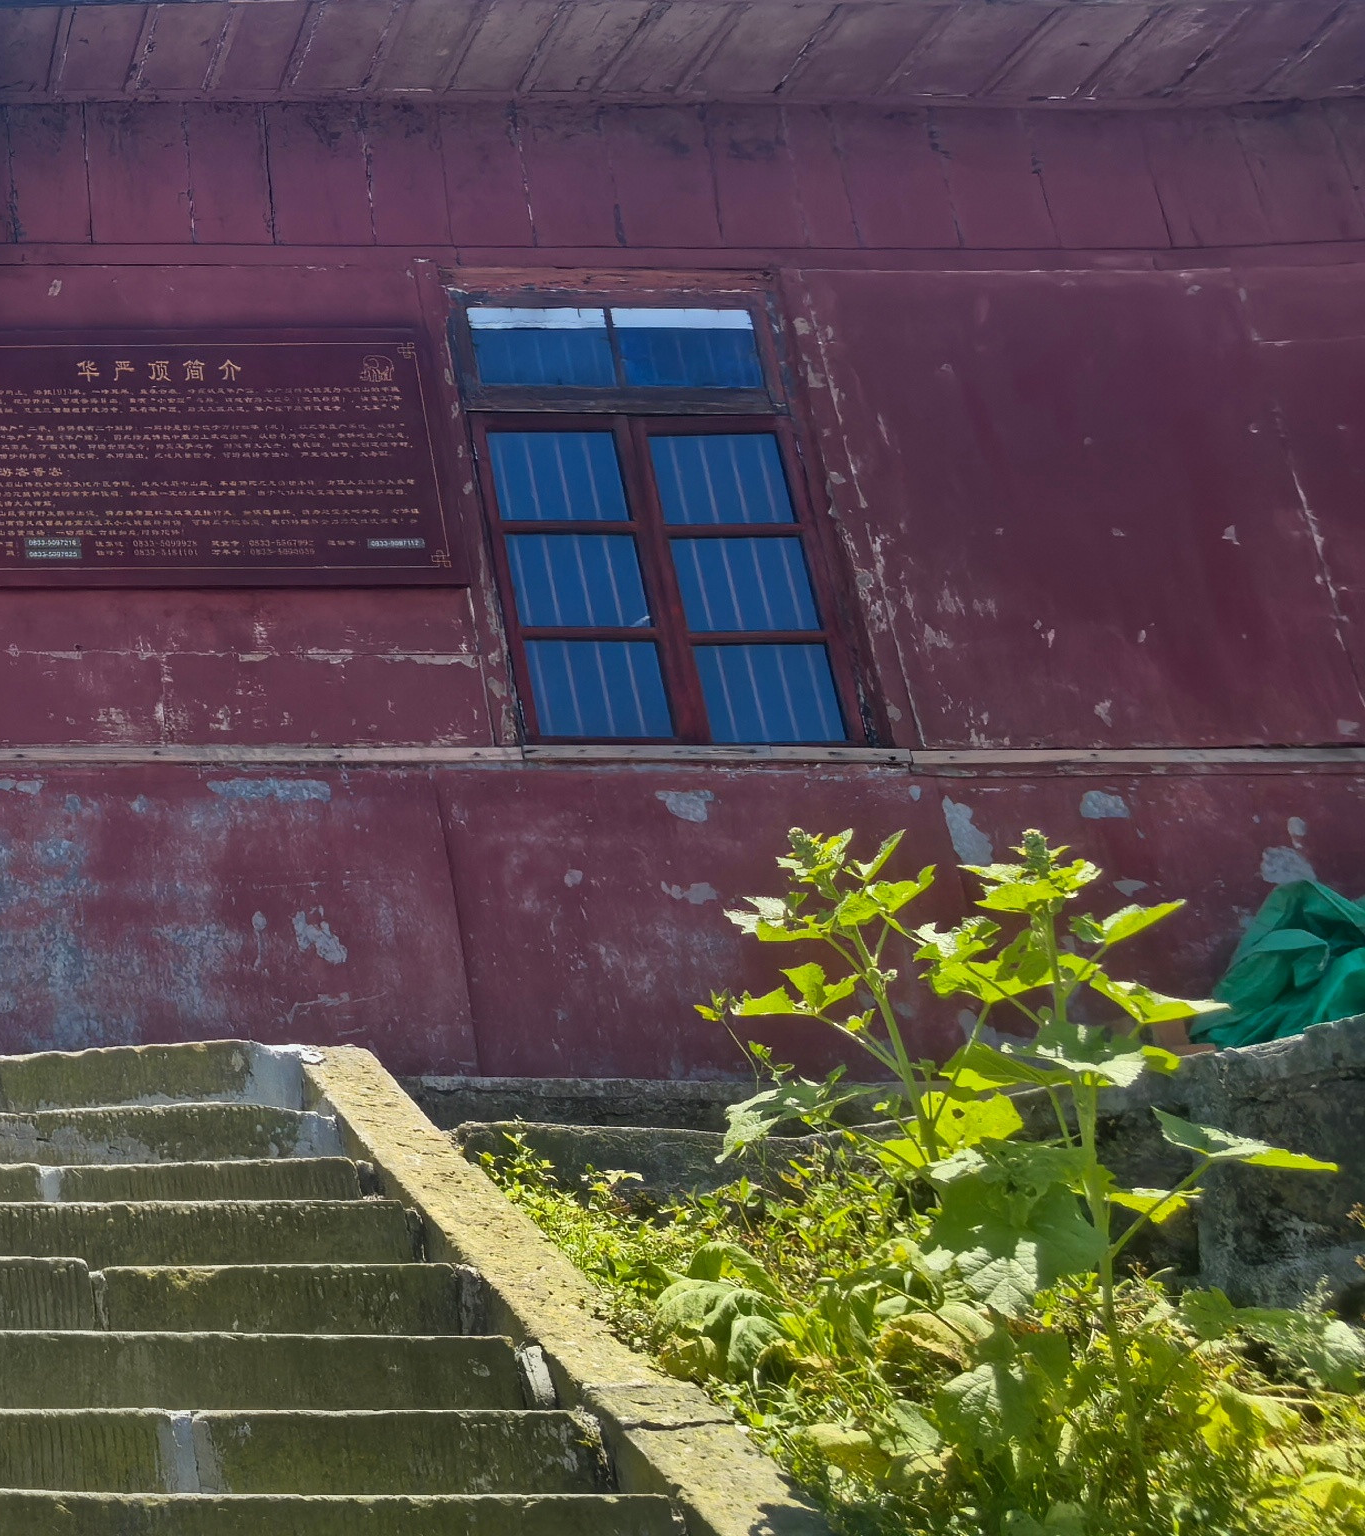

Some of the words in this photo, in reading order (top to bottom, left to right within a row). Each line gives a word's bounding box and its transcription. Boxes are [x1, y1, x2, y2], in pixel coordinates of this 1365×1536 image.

[77, 358, 242, 383] 华严顶简介
